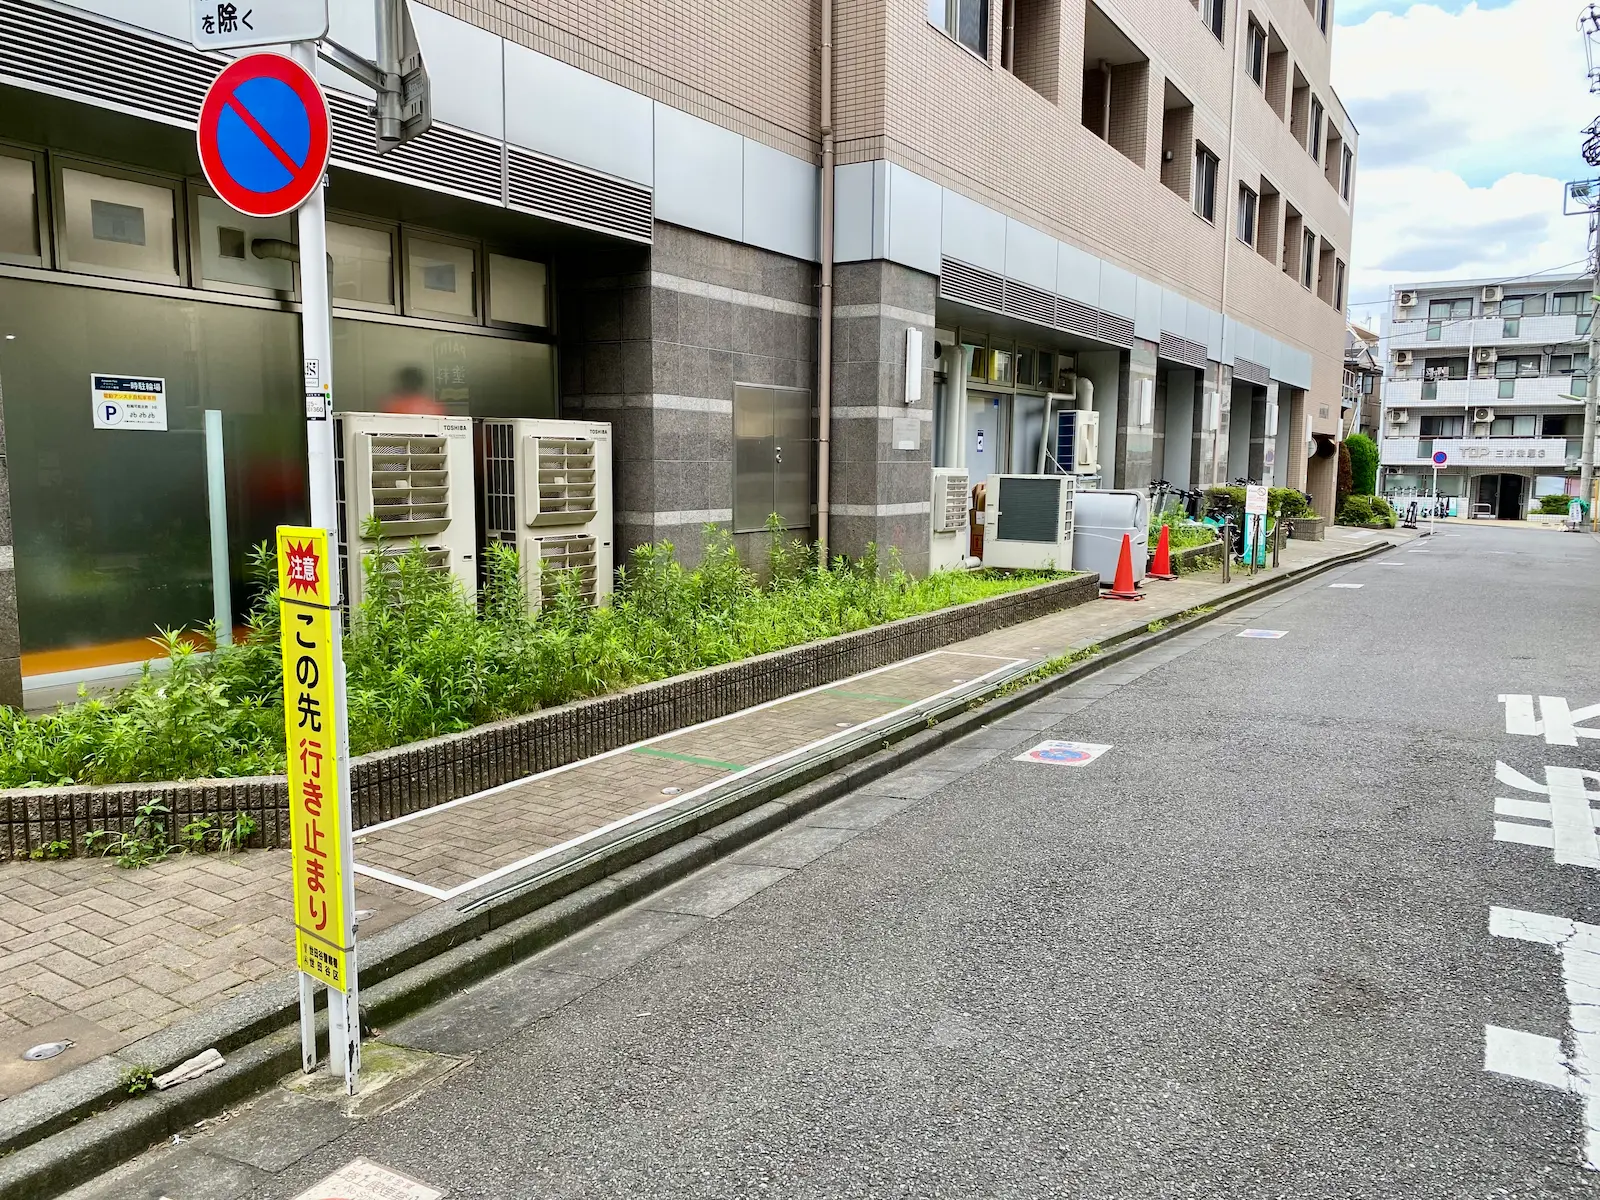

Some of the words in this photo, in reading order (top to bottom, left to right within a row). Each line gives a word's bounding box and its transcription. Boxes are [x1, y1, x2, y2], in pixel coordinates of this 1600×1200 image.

[202, 2, 254, 34] を除く
[105, 405, 117, 420] P
[1460, 446, 1490, 458] TOP
[290, 555, 316, 582] 注意
